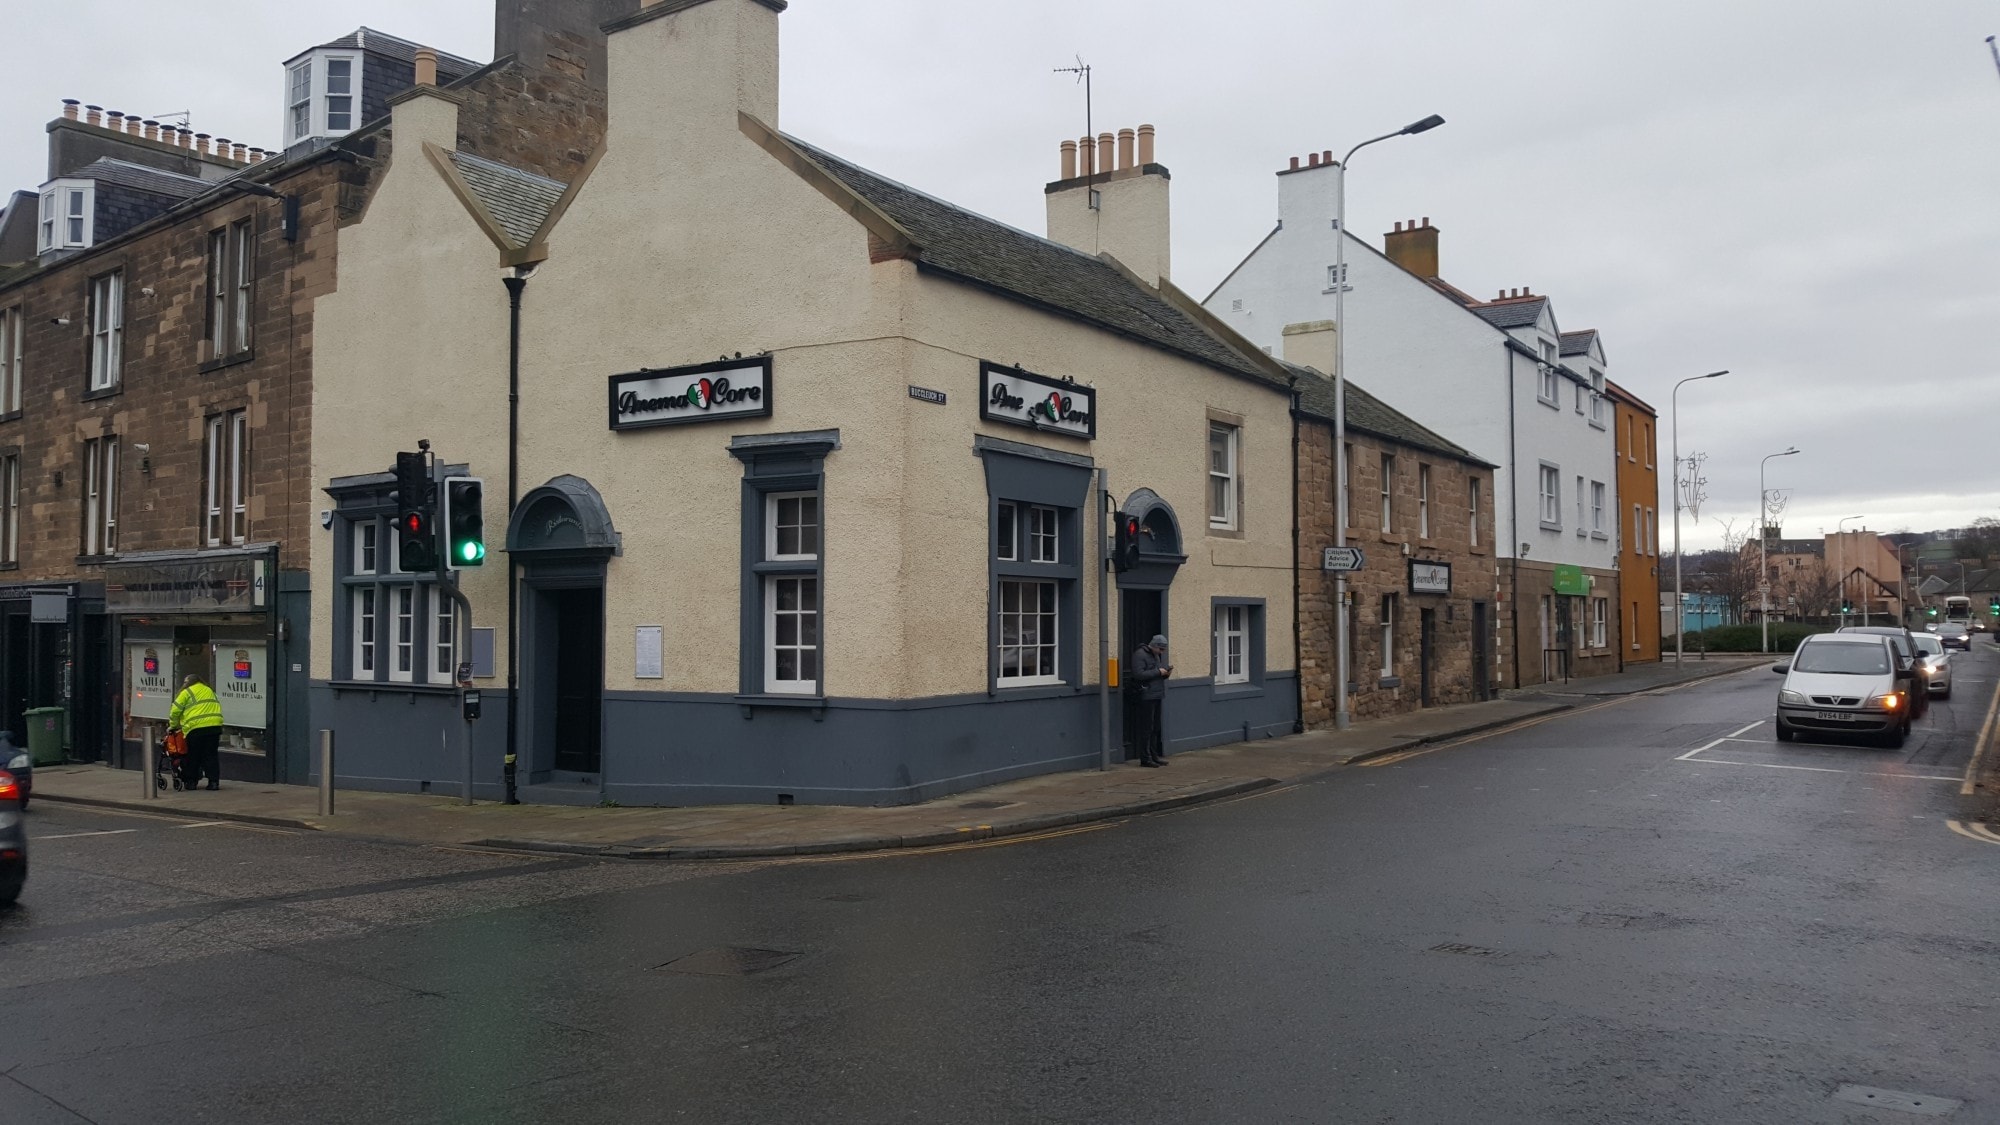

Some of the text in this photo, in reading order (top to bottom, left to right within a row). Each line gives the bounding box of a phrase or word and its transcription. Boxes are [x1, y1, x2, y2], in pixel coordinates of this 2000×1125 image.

[618, 391, 689, 414] Anema
[713, 378, 761, 404] Core
[911, 387, 938, 401] BUCCLEUCH
[255, 577, 263, 591] 4
[227, 682, 257, 693] NATURAL
